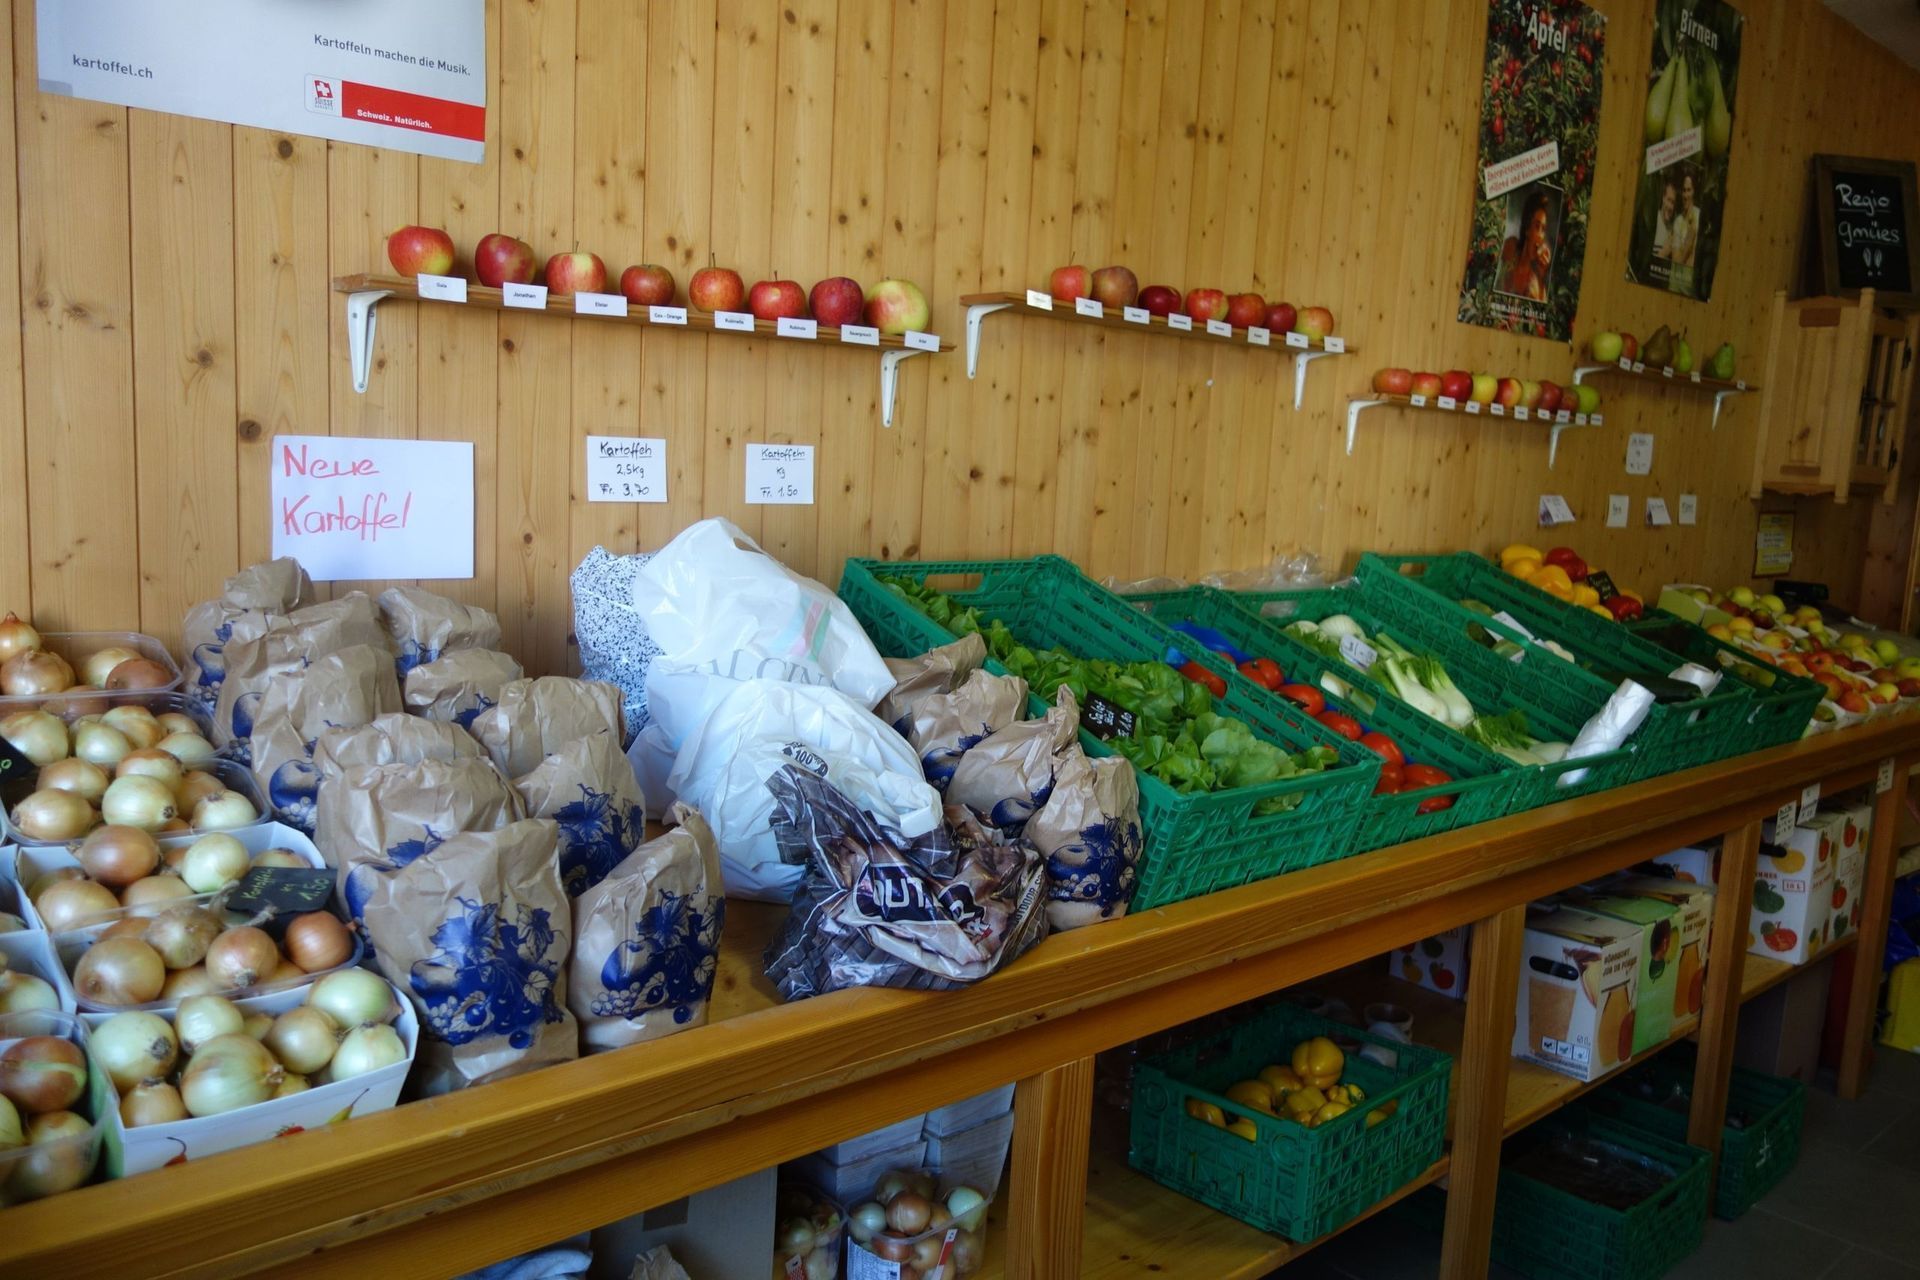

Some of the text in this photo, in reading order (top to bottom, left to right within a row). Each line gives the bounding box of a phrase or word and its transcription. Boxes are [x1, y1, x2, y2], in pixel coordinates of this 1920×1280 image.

[1527, 4, 1568, 53] Äpfel
[1680, 8, 1718, 51] Birnen
[72, 53, 154, 80] kartoffel.ch
[313, 34, 471, 76] Kartoffeln machen die Musik.
[357, 108, 433, 129] Schweiz. Natürlich.
[1835, 184, 1889, 216] Regio
[512, 291, 538, 300] Jonathan
[283, 444, 381, 478] Neue
[283, 491, 411, 542] Kartoffel
